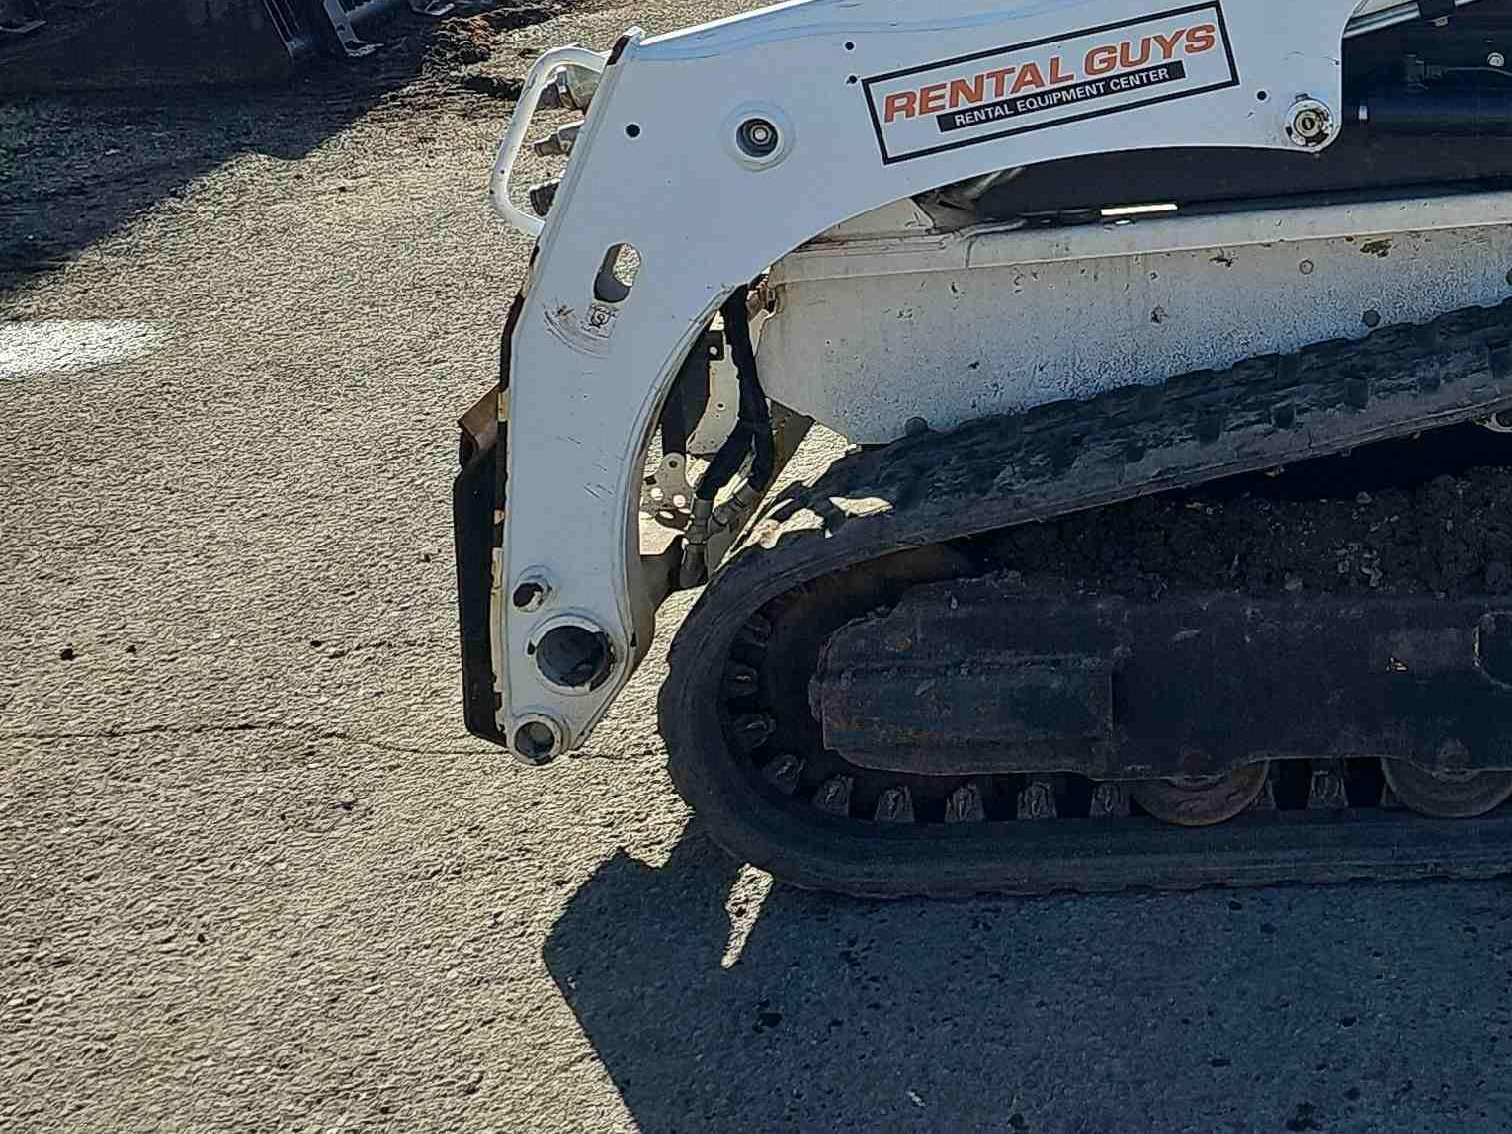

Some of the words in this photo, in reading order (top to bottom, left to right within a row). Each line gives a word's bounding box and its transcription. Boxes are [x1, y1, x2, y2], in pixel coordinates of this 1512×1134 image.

[883, 56, 1075, 123] RENTAL
[1084, 24, 1216, 76] GUYS
[955, 103, 1014, 127] RENTAL
[1016, 81, 1106, 113] EQUIPMENT
[1109, 66, 1171, 91] CENTER
